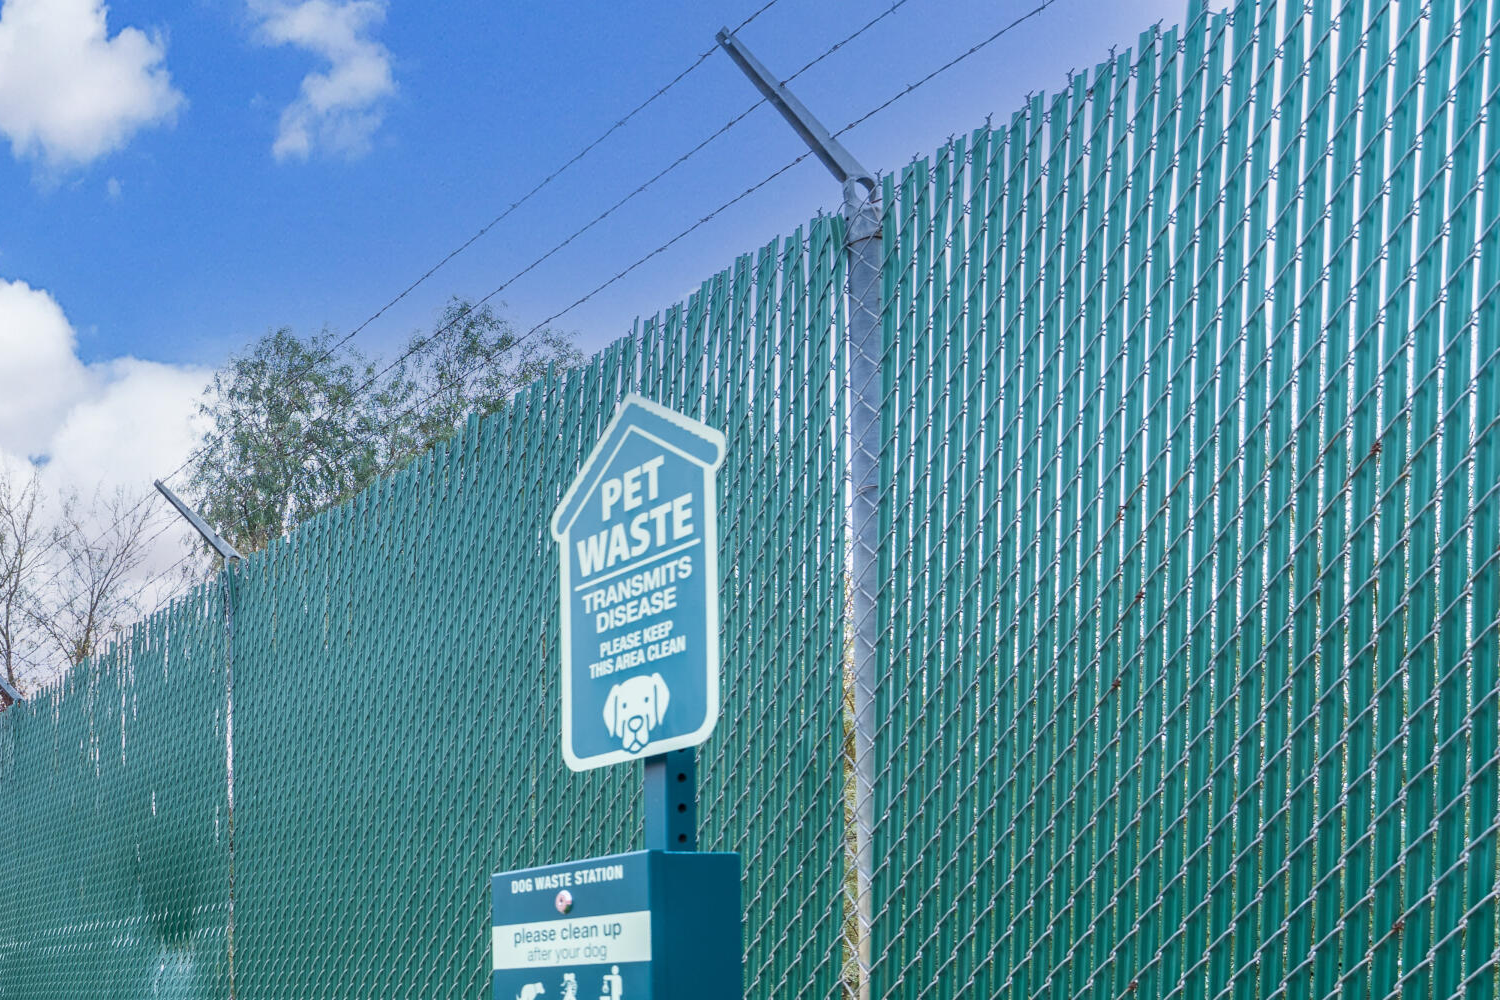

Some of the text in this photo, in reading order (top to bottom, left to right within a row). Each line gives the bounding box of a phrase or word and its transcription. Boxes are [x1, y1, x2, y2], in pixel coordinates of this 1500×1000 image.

[601, 455, 664, 522] PET
[576, 492, 694, 577] WASTE
[581, 555, 693, 614] TRANSMITS
[596, 586, 677, 634] DISEASE
[589, 635, 687, 679] THIS AREA CLEAN
[600, 620, 674, 658] PLEASE KEEP
[511, 865, 624, 894] DOG WASTE STATION
[513, 922, 622, 948] please clean up
[527, 944, 607, 963] after your dog
